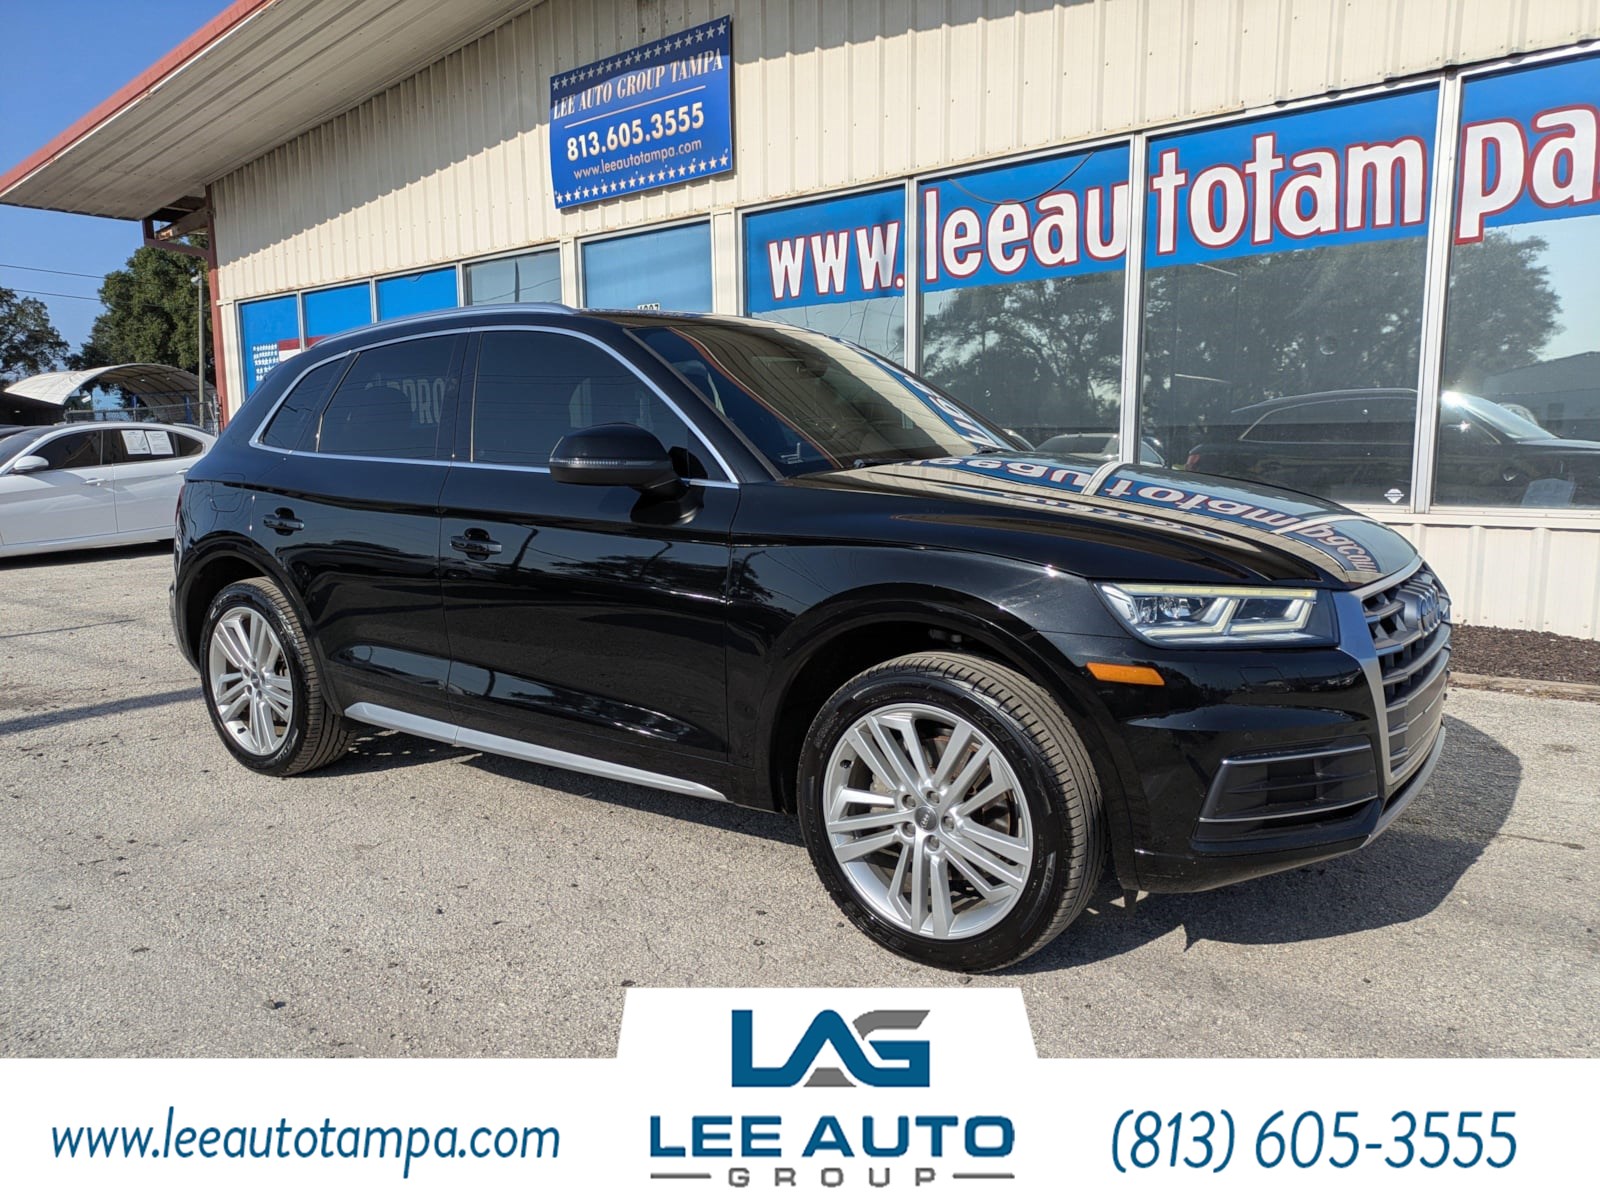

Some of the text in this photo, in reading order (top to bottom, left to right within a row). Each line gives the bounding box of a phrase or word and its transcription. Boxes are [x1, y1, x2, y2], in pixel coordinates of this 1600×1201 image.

[553, 48, 723, 120] LEE AUTO GROUP TAMPA
[567, 102, 705, 161] 813.605.3555
[573, 138, 703, 180] www.leeautotampa.com
